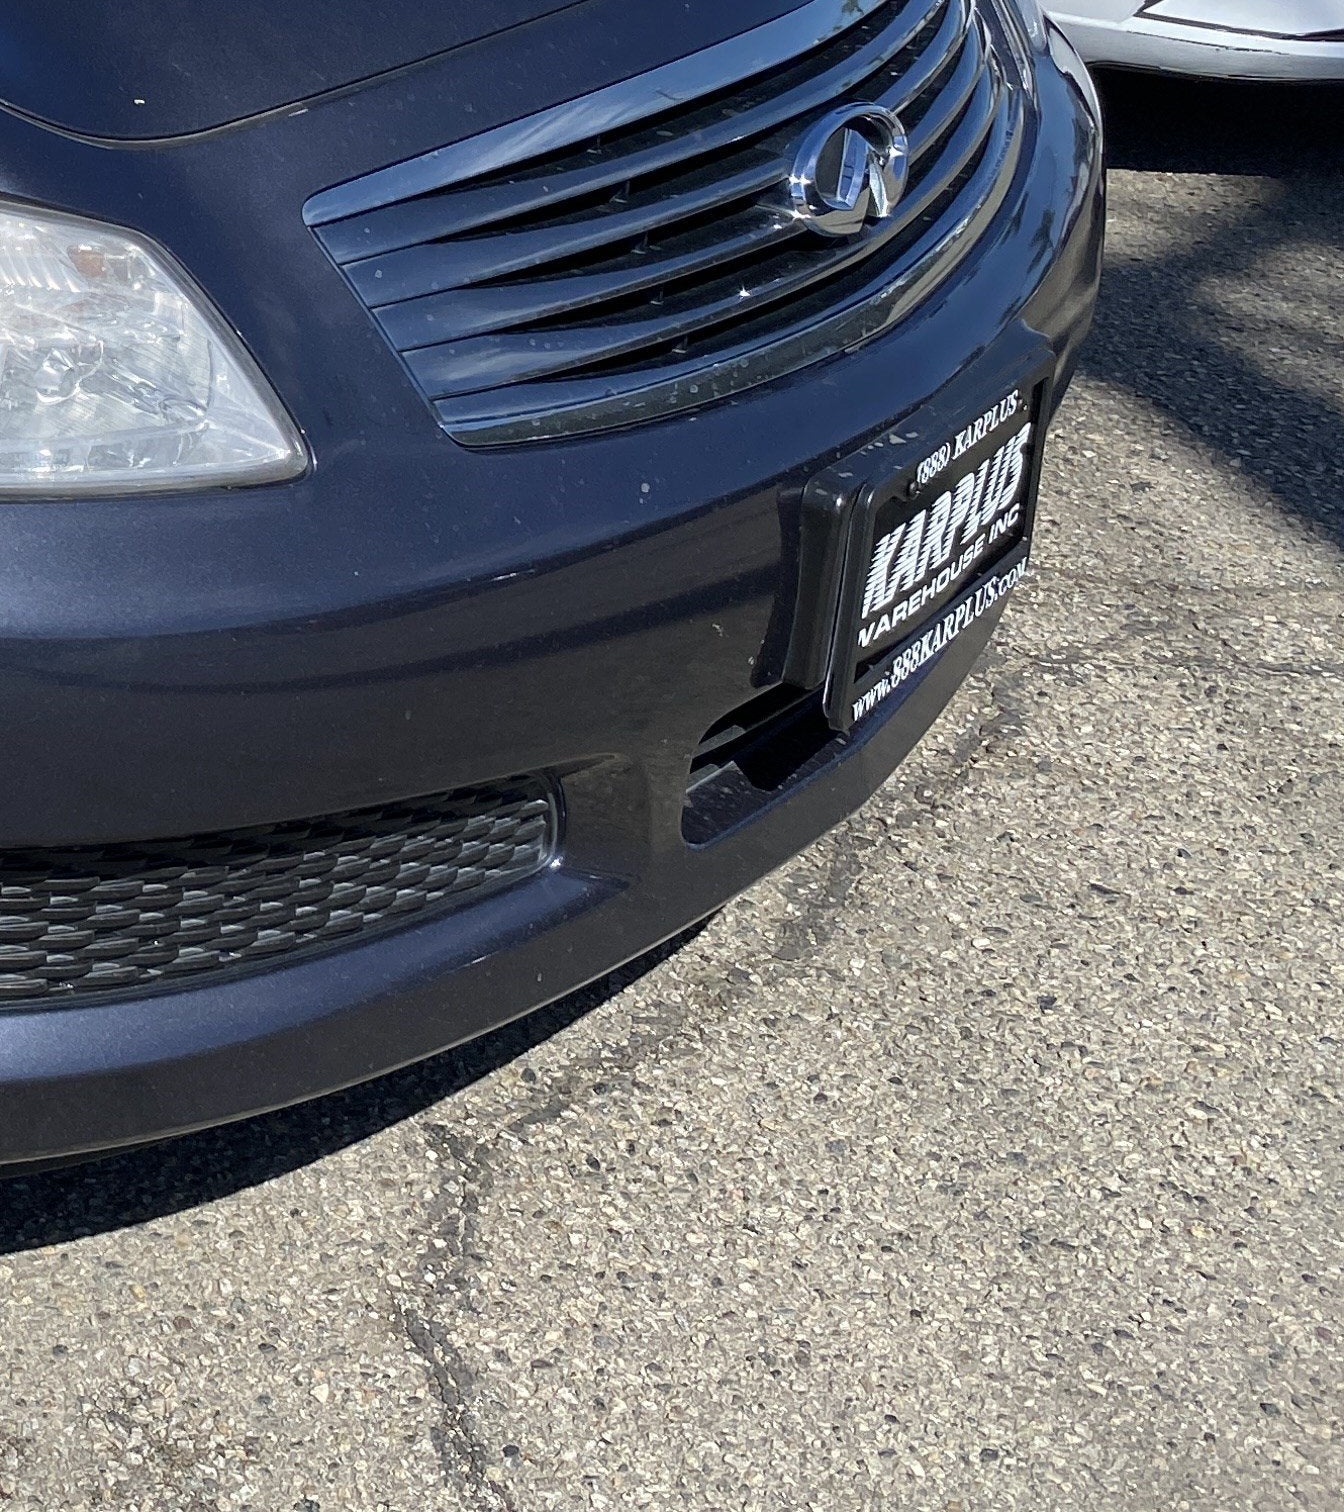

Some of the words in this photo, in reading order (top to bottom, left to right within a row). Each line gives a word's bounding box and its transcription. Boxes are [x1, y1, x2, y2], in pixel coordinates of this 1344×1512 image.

[916, 442, 951, 484] (888)
[952, 389, 1019, 460] KARPLUS
[857, 533, 986, 648] WAREHOUSE
[988, 502, 1020, 544] INC
[862, 422, 1031, 619] KARPLUS
